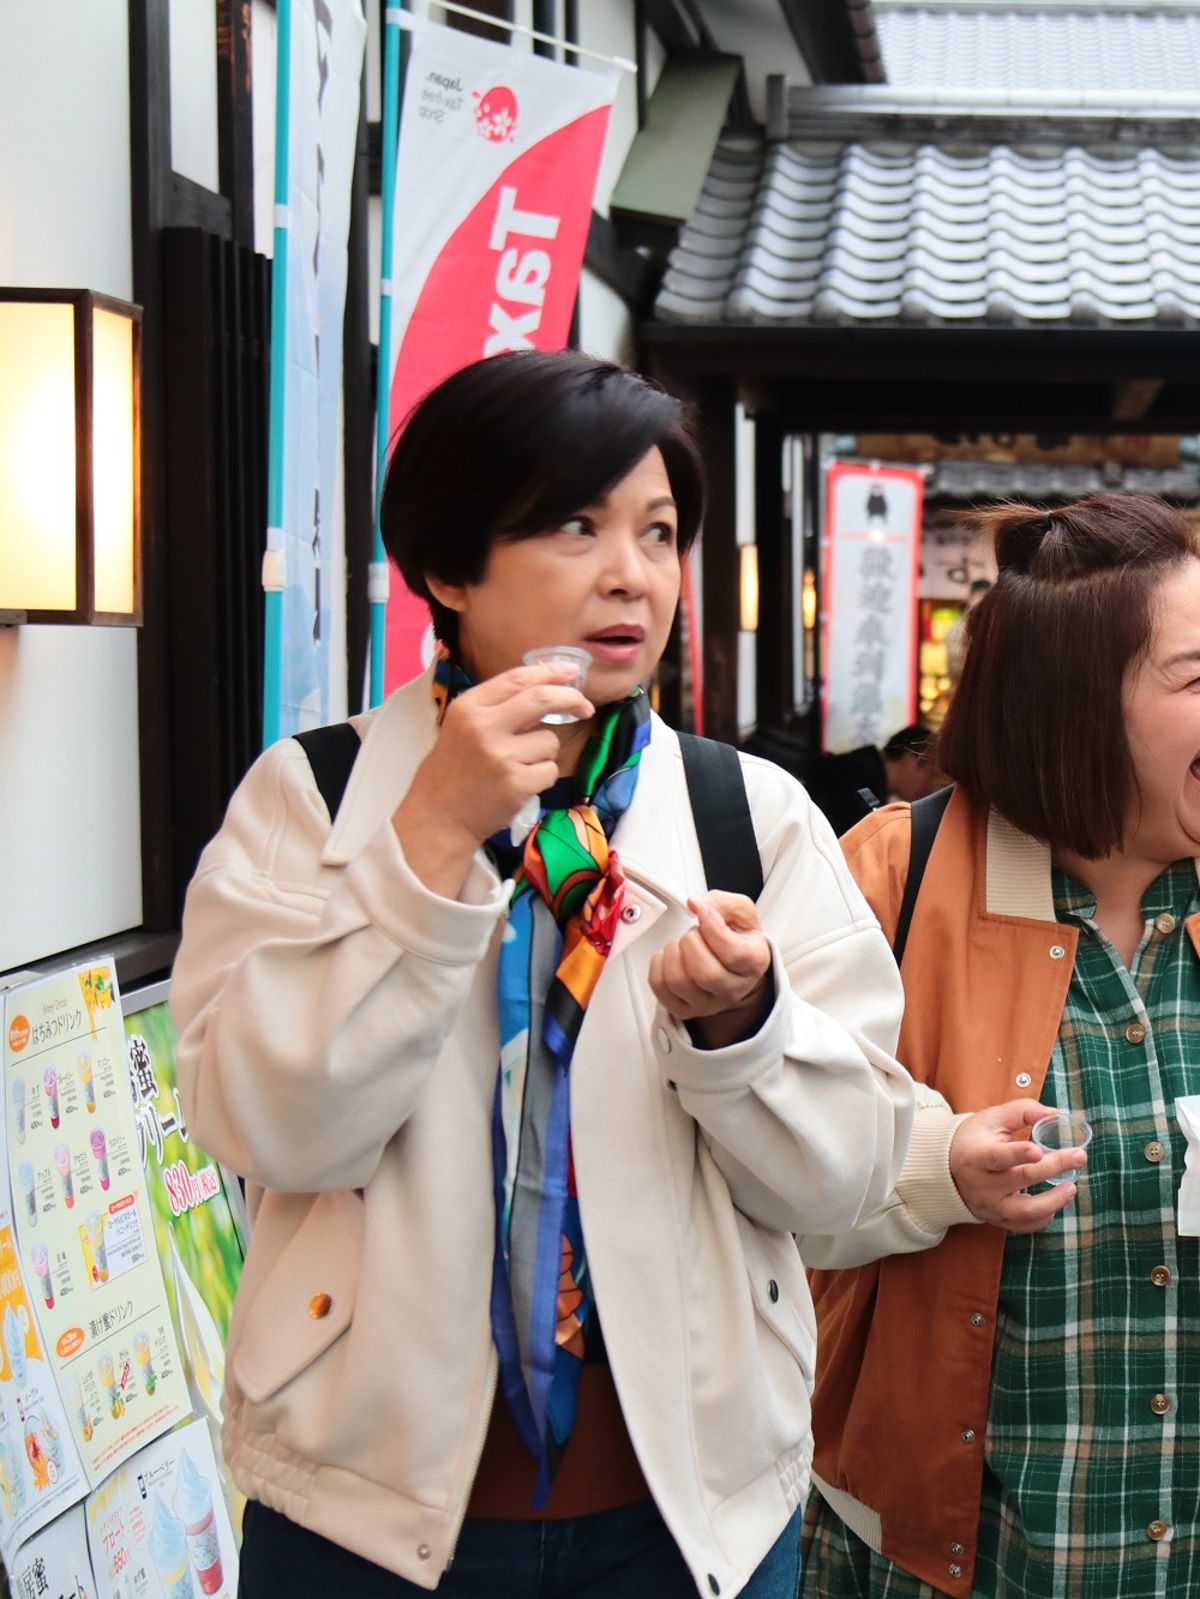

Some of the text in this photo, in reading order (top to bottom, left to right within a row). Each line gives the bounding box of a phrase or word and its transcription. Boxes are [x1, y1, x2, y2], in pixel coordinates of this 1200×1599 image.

[32, 1010, 82, 1045] はちみつドリンク
